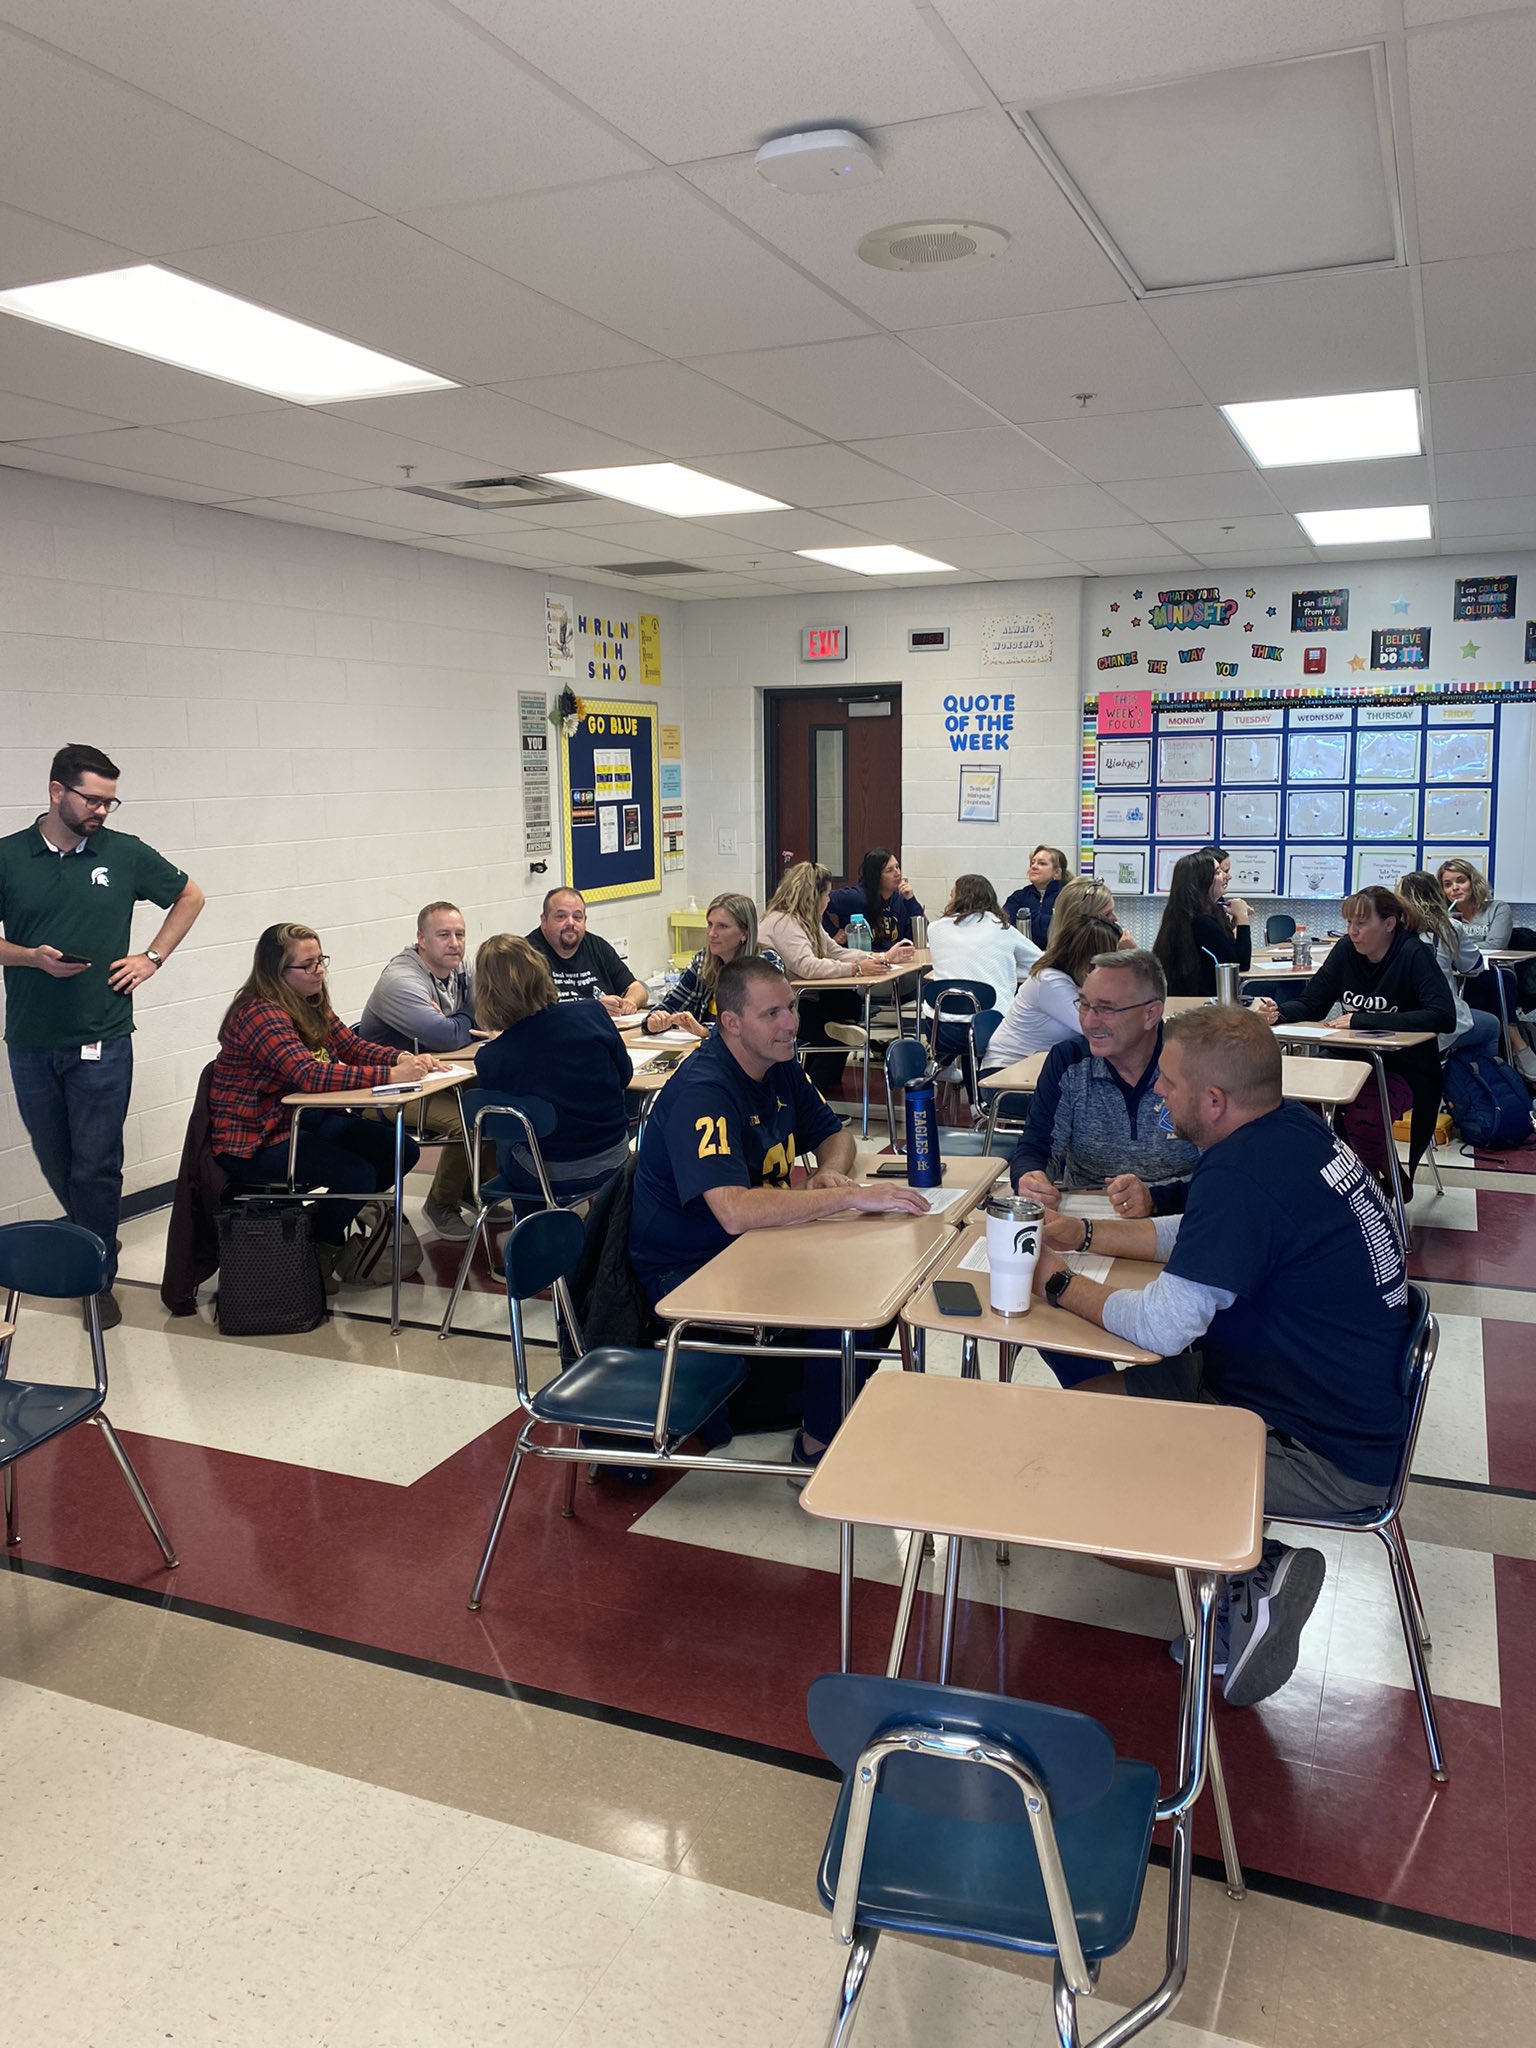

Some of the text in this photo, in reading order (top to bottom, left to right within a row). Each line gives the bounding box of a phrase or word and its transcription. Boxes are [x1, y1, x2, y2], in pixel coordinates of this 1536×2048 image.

[1478, 583, 1498, 593] COME
[1159, 589, 1219, 602] WHAT IS YOUR
[1153, 599, 1238, 626] MINDSET?
[1303, 607, 1337, 616] from my
[1459, 603, 1509, 615] SOLUTIONS.
[1296, 616, 1343, 628] MISTAKES.
[1002, 625, 1035, 635] ALWAYS
[809, 630, 840, 657] EXIT
[993, 639, 1045, 651] WONDERFUL
[1385, 633, 1422, 645] BELIEVE
[1097, 644, 1284, 677] CHANGE THE WAY YOU THINK
[1379, 652, 1398, 665] DO
[943, 694, 1016, 714] QUOTE
[1114, 694, 1138, 705] THIS
[1106, 706, 1143, 719] WEEK'S
[1297, 712, 1344, 722] WEDNESDAY
[1366, 711, 1414, 720] THURSDAY
[1443, 709, 1475, 718] FRIDAY
[588, 715, 638, 736] GO BLUE
[945, 714, 1014, 732] OF THE
[1108, 719, 1142, 730] FOCUS
[1168, 717, 1206, 726] MONDAY
[1234, 715, 1272, 725] TUESDAY
[527, 737, 543, 750] YOU
[949, 733, 1009, 752] WEEK
[1343, 990, 1388, 1010] GOOD
[695, 1115, 732, 1159] 21
[913, 1110, 929, 1155] EAGLES
